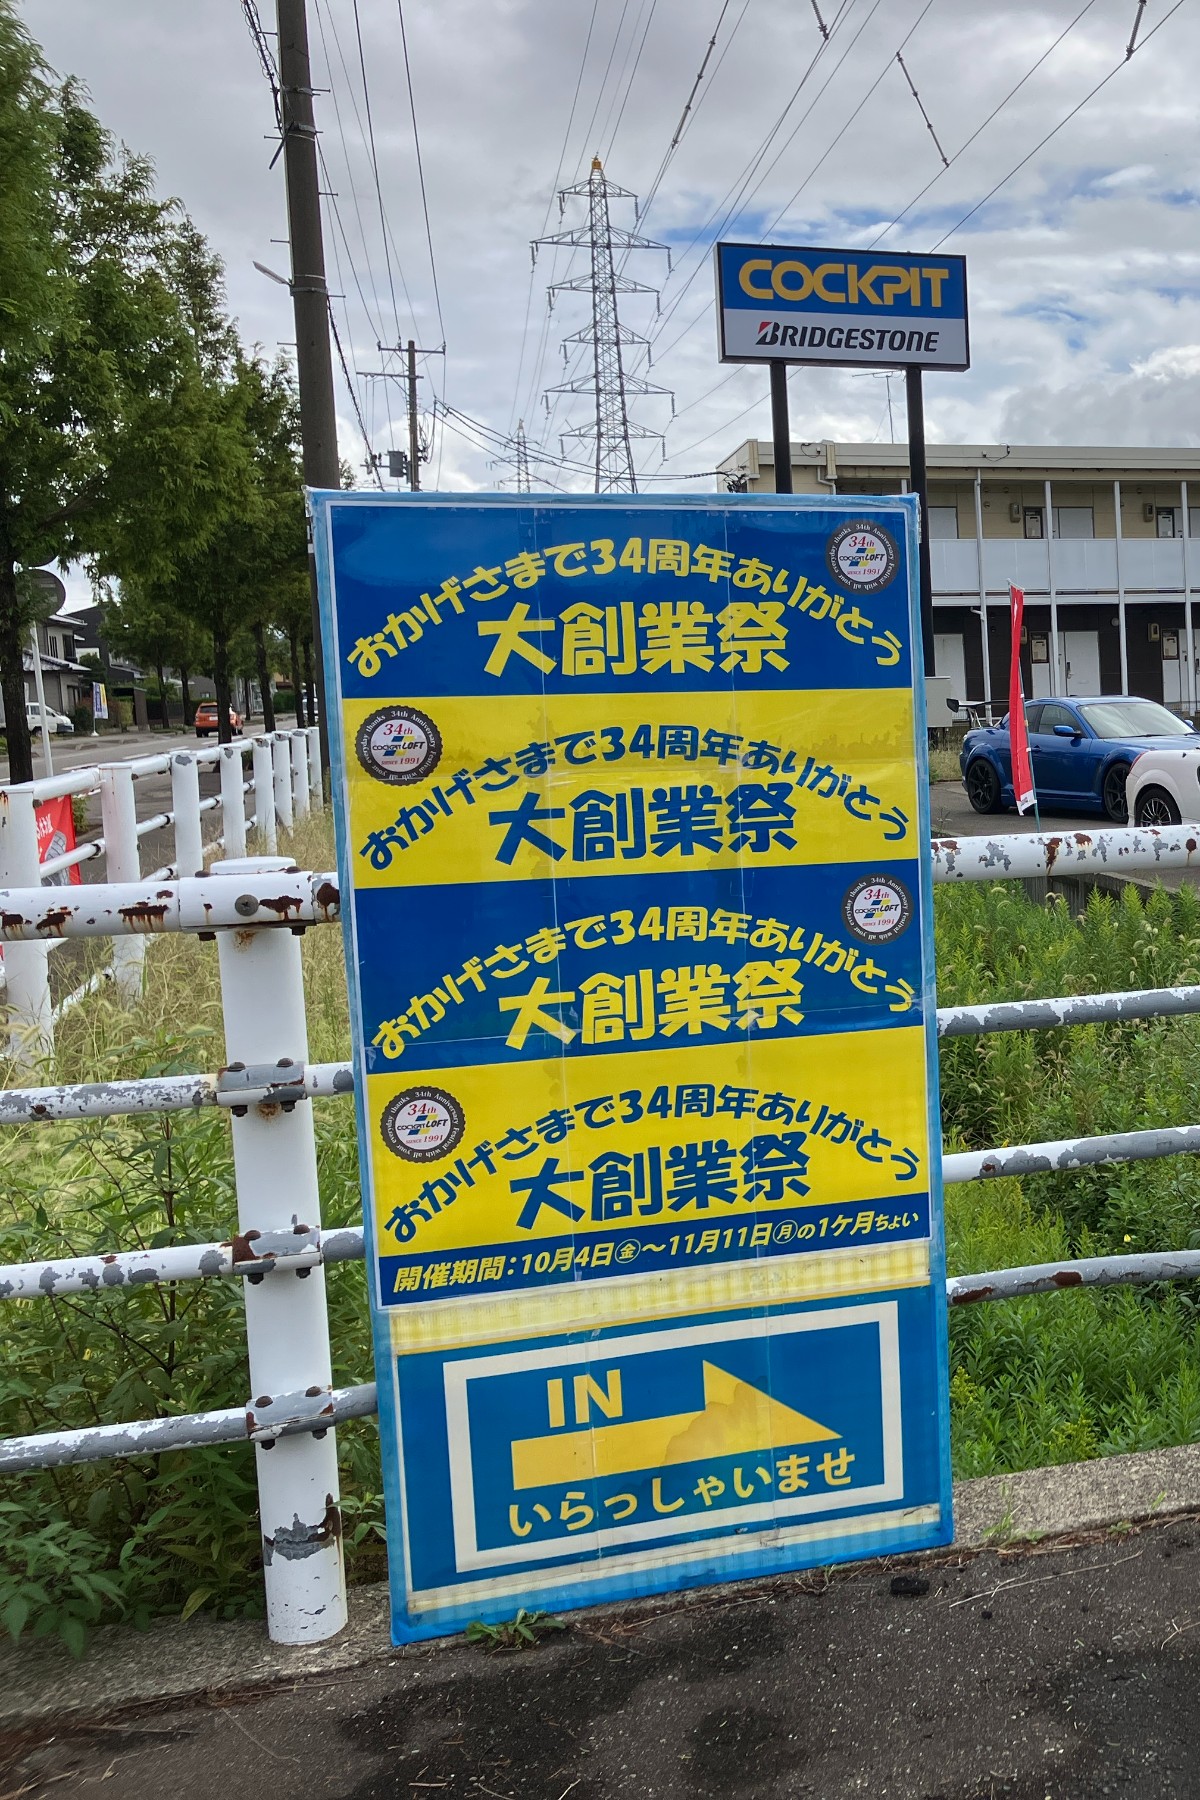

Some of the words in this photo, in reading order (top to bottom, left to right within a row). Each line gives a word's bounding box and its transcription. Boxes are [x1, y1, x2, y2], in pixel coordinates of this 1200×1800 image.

[739, 259, 949, 308] COCKPIT
[755, 321, 939, 353] BRIDGESTONE
[848, 535, 875, 547] 34th
[865, 553, 885, 561] LOFT
[347, 537, 903, 679] おかげさまで34周年ありがとう
[478, 601, 791, 679] 大創業祭
[383, 723, 413, 736] 34th
[402, 741, 426, 750] LOFT
[400, 757, 420, 765] 1991
[358, 724, 910, 871] おかげさまで34周年ありがとう
[488, 783, 800, 866] 大創業祭
[864, 888, 890, 900] 34th
[880, 903, 900, 912] LOFT
[370, 906, 917, 1061] おかげさまで34周年ありがとう
[499, 959, 806, 1051] 大創業祭
[407, 1103, 437, 1116] 34th
[426, 1119, 449, 1128] LOFT
[424, 1135, 443, 1143] 1991
[384, 1084, 921, 1245] おかげさまで34周年ありがとう
[510, 1132, 813, 1231] 大創業祭
[547, 1369, 623, 1429] IN
[509, 1446, 856, 1538] いらっしゃいませ
